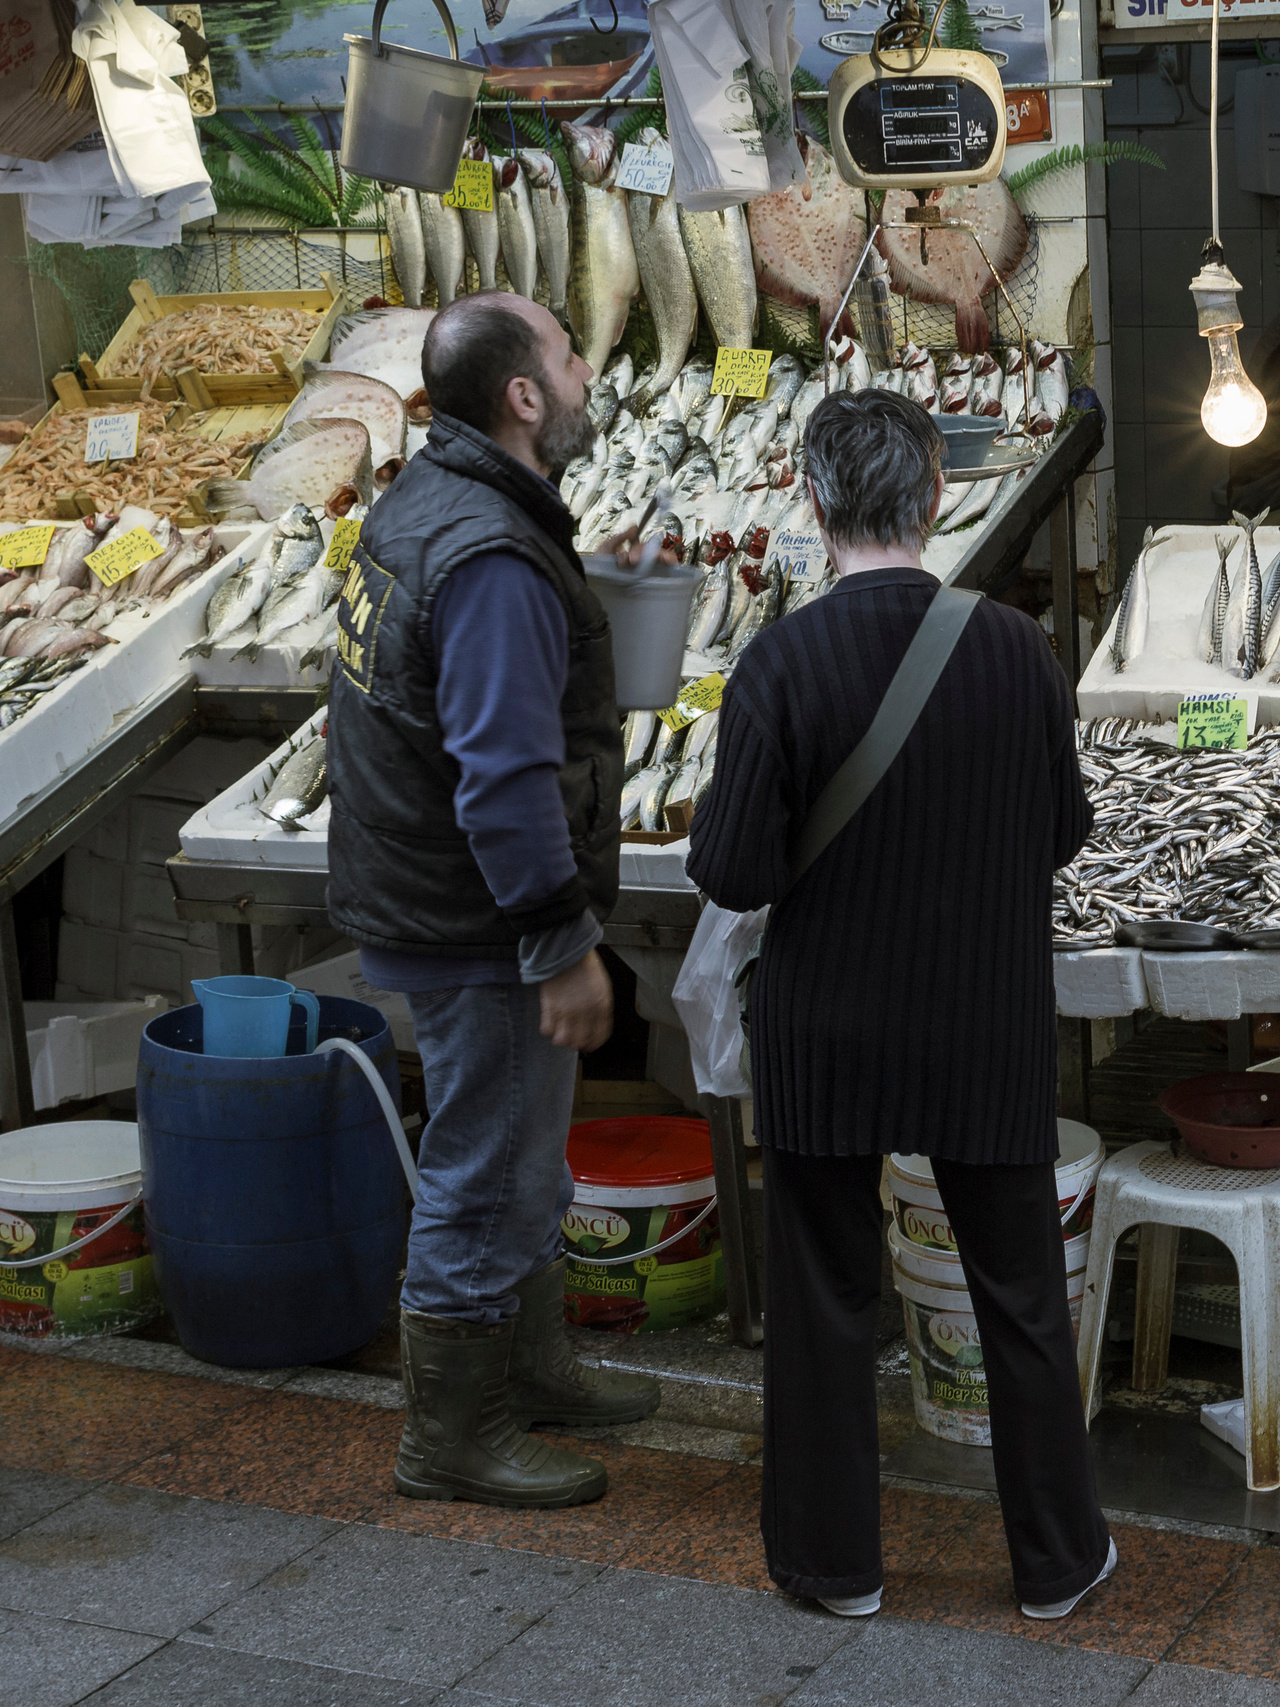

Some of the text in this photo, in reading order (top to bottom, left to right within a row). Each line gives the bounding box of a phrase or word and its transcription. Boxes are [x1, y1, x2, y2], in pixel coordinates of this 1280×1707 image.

[892, 82, 935, 92] TOPLAM FİYAT
[0, 1220, 25, 1242] CÜ
[563, 1209, 620, 1237] ÖNCÜ
[0, 1281, 45, 1300] Salçası
[566, 1271, 585, 1285] ber
[587, 1275, 637, 1293] Salçası
[933, 1380, 969, 1402] Biber
